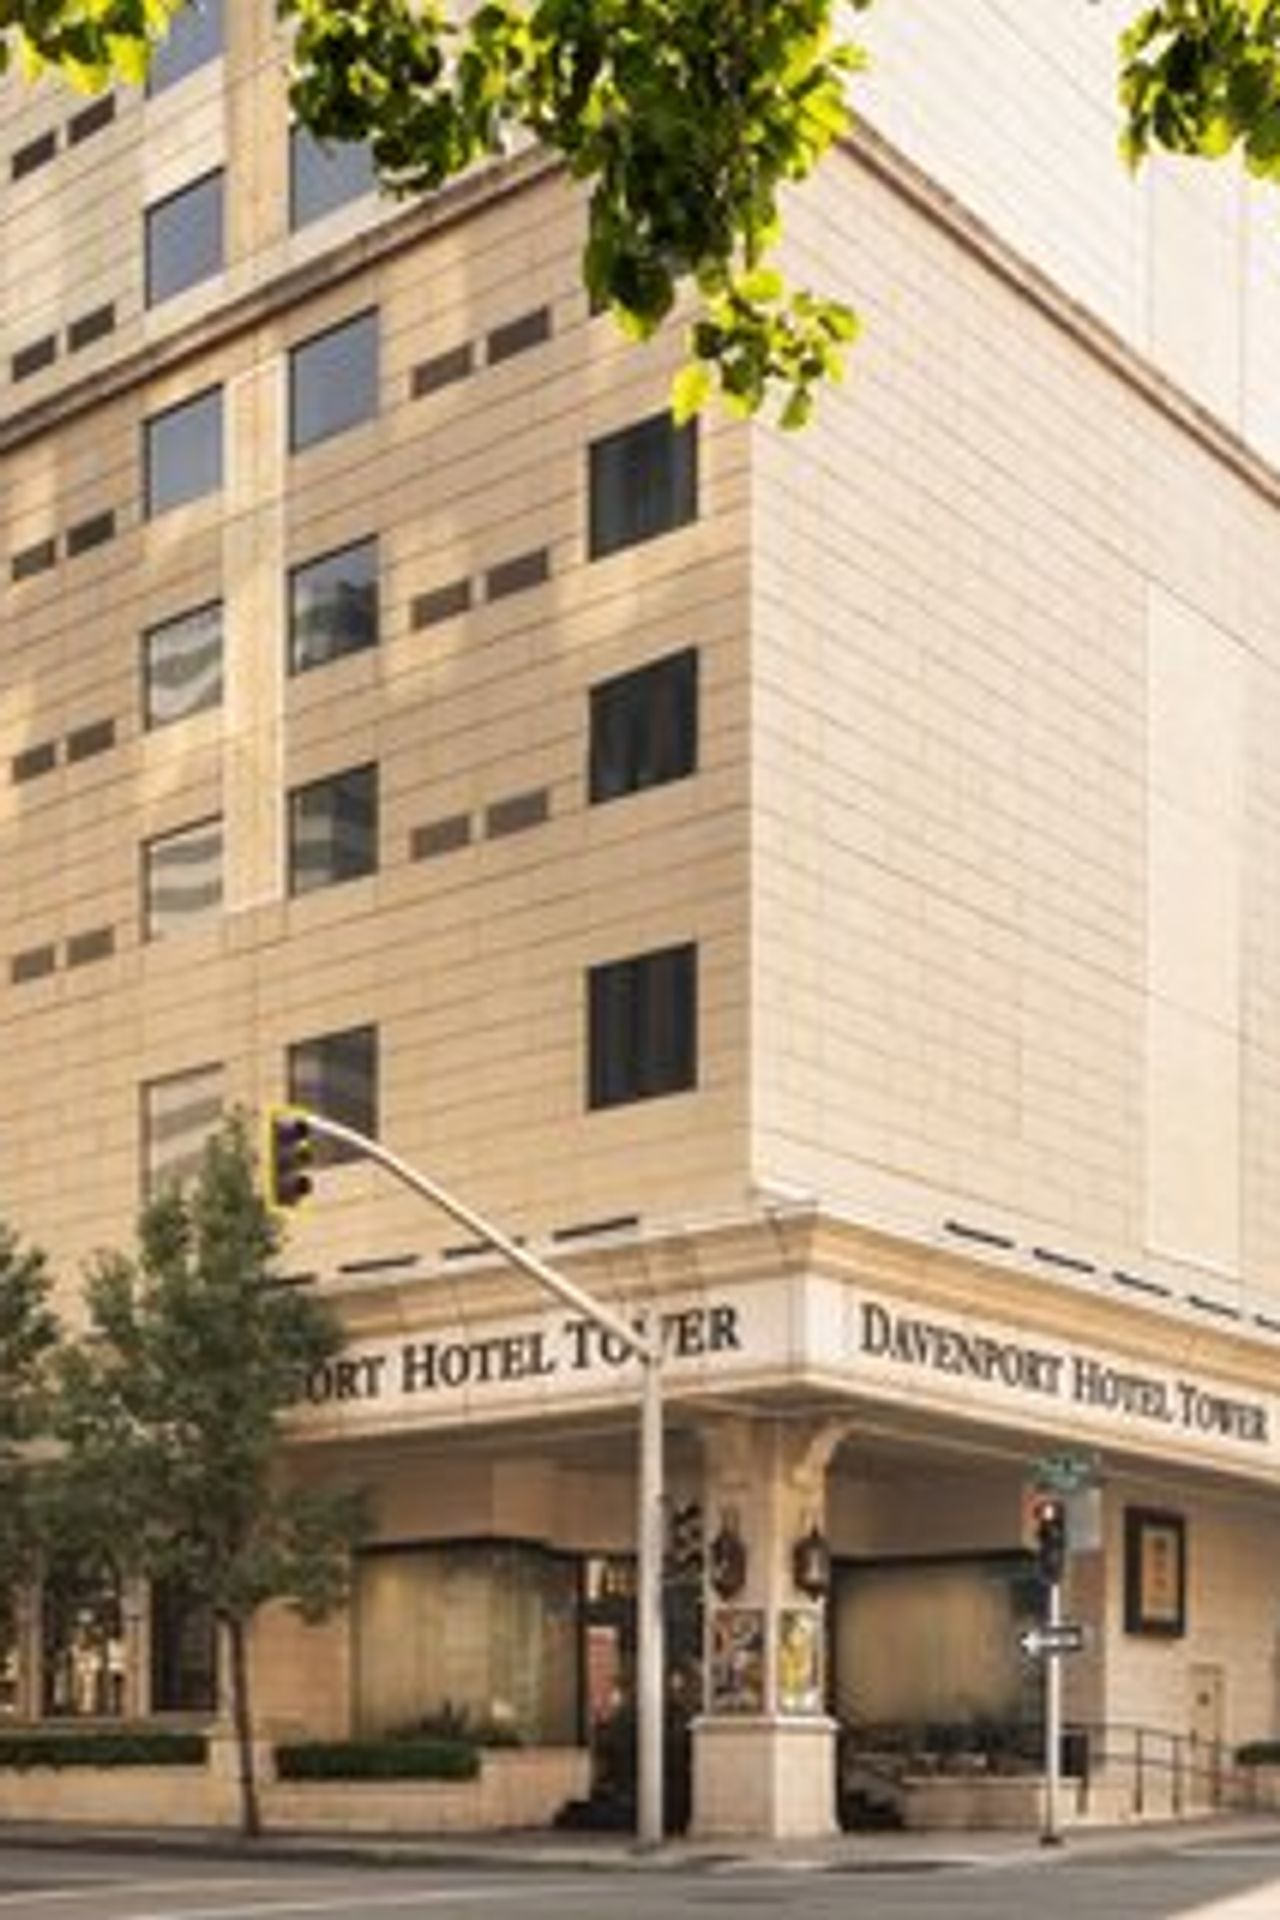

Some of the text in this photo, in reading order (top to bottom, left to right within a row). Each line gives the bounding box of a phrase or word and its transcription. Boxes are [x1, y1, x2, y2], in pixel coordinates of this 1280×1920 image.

[402, 1331, 556, 1393] HOTEL
[859, 1301, 1269, 1442] DAVENPORT HOTEL TOWER
